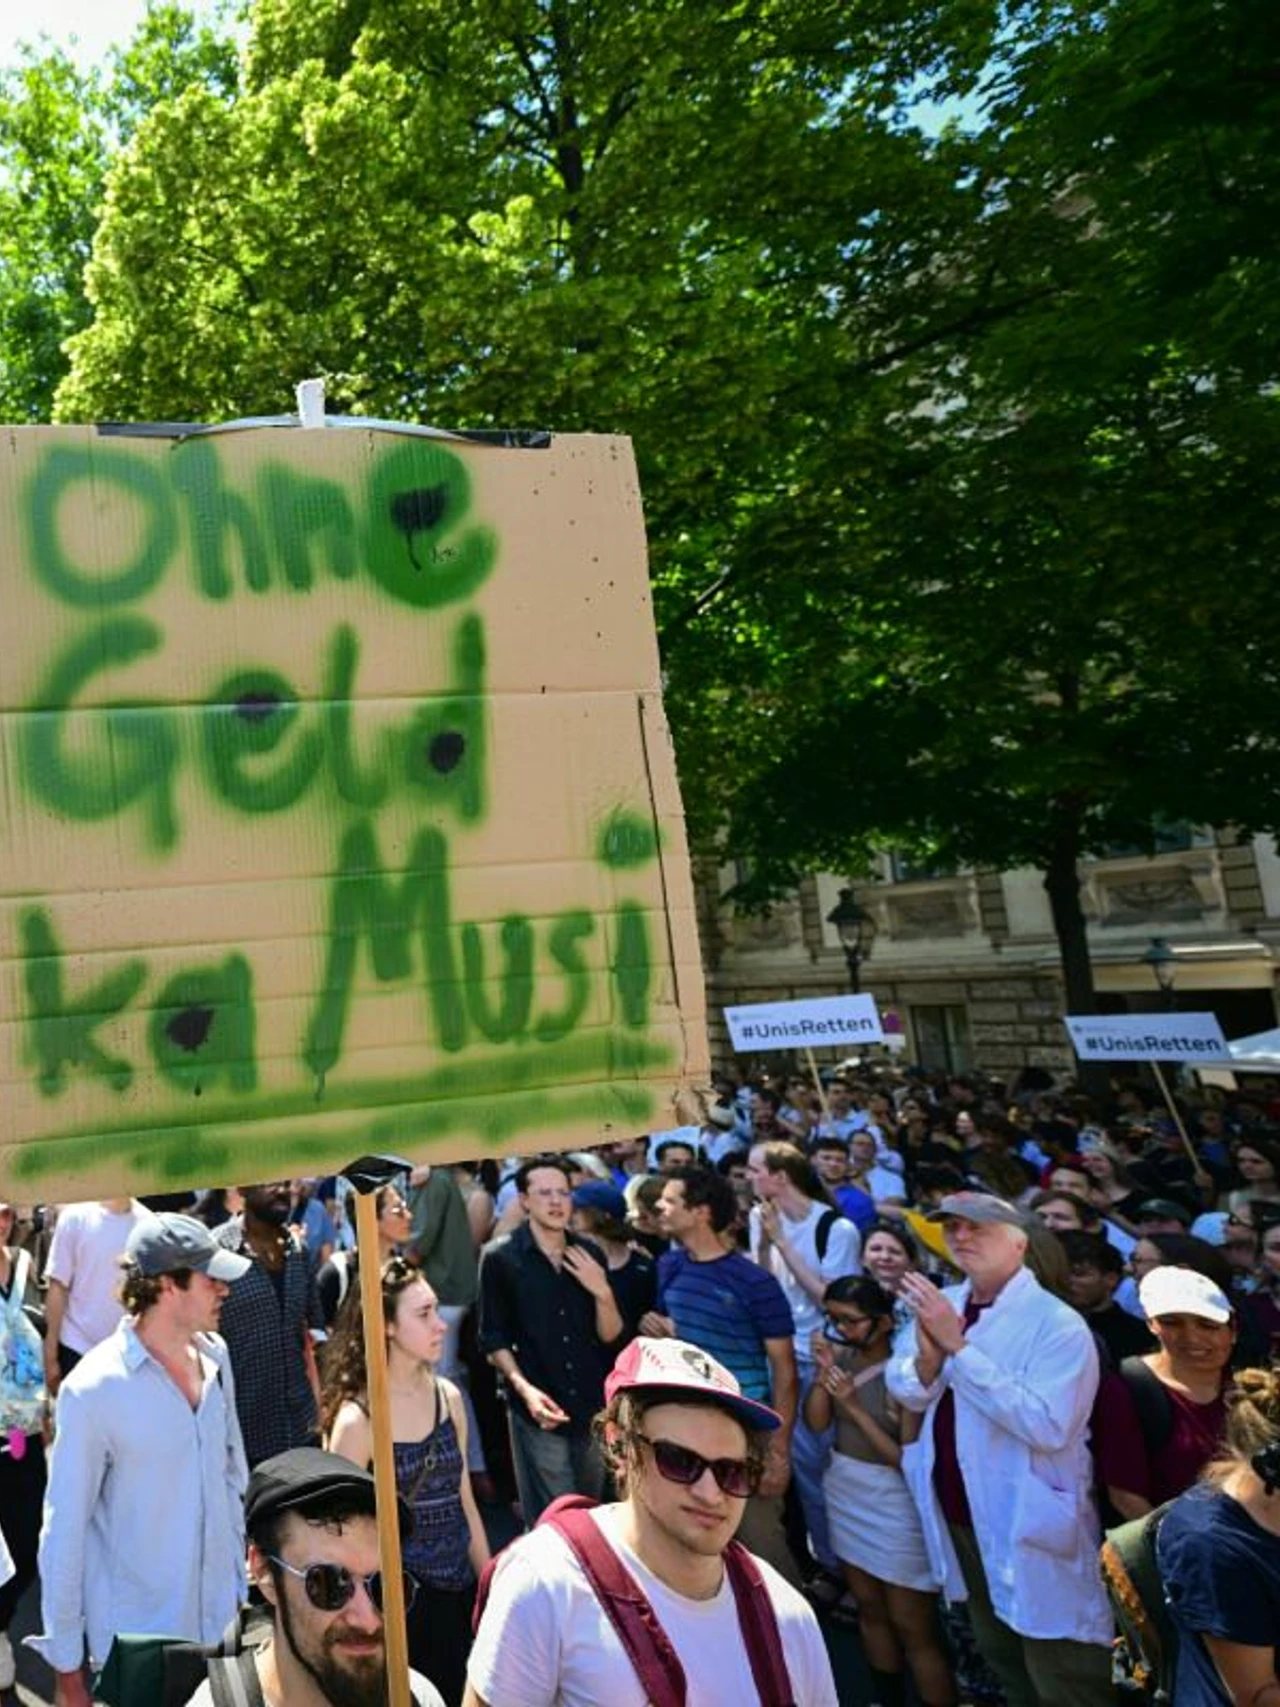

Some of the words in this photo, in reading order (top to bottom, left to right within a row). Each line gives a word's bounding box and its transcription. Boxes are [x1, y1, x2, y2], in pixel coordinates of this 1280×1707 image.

[26, 440, 498, 608] Ohne
[20, 612, 488, 860] Geld
[16, 904, 259, 1099] ka
[742, 1016, 874, 1039] #UnisRetten
[1085, 1034, 1220, 1052] #UnisRetten
